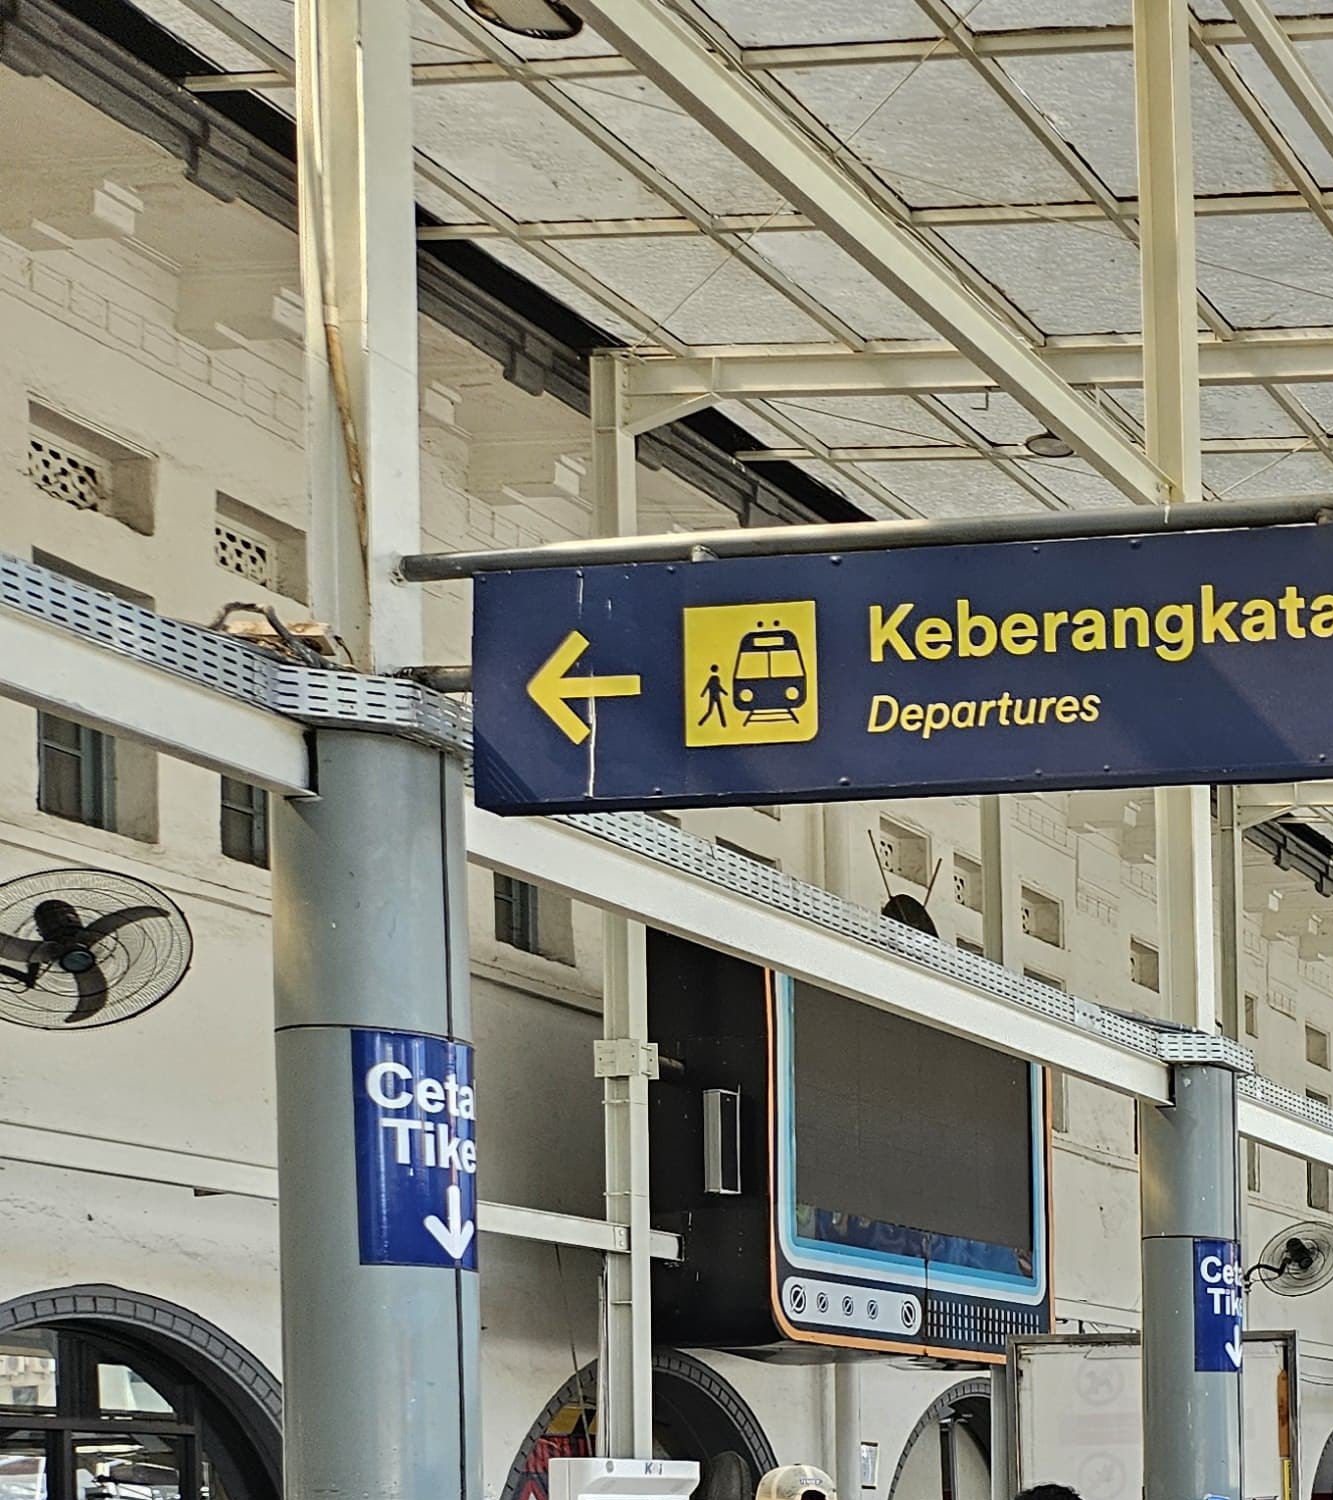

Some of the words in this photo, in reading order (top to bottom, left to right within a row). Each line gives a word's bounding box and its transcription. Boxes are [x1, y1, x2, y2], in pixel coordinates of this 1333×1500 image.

[867, 691, 1101, 739] Departures
[366, 1062, 476, 1120] Ceta
[379, 1118, 477, 1173] Tike
[1200, 1256, 1242, 1286] Cet
[1206, 1287, 1242, 1316] Tik
